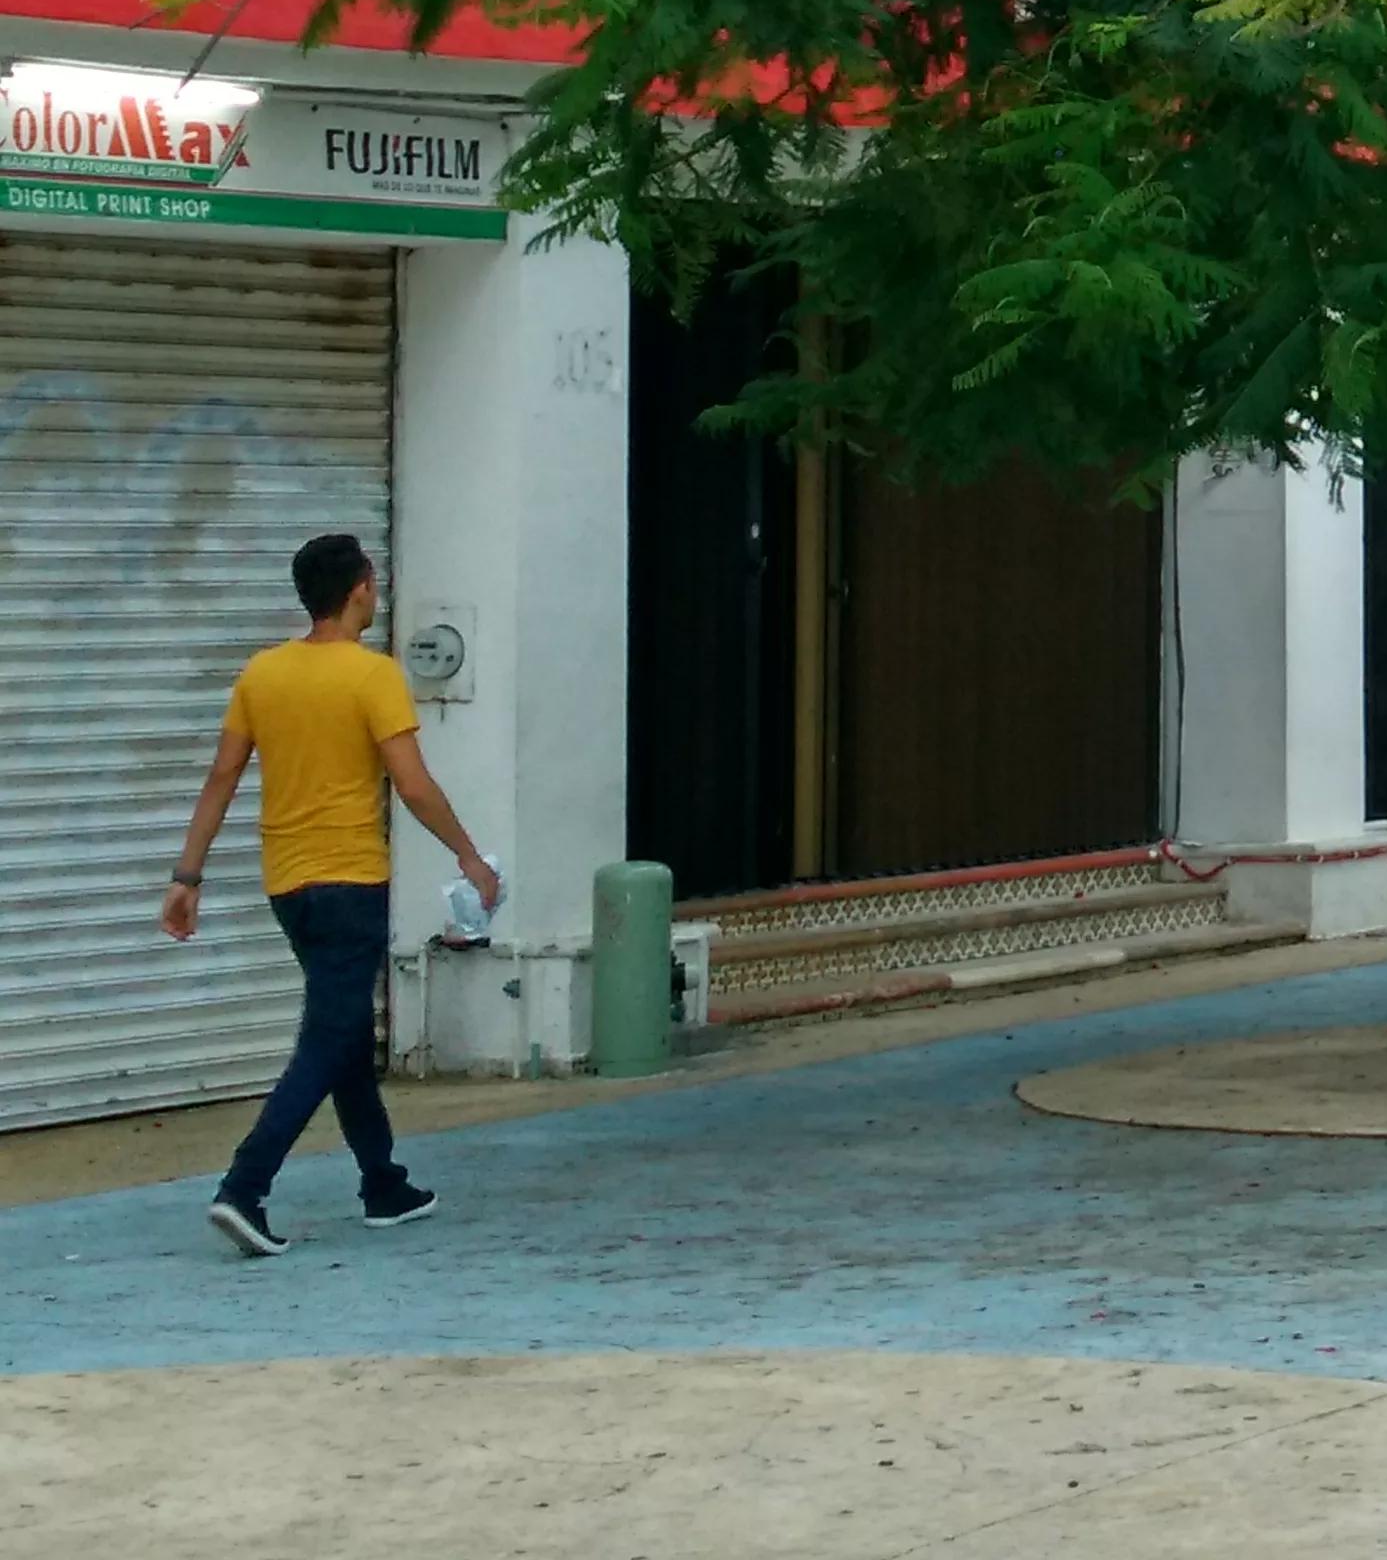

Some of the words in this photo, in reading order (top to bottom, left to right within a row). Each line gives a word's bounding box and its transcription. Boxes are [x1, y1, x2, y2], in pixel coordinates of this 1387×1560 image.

[325, 128, 480, 180] FUJIFILM
[8, 187, 89, 211] DIGITAL
[97, 192, 152, 217] PRINT
[159, 197, 212, 218] SHOP
